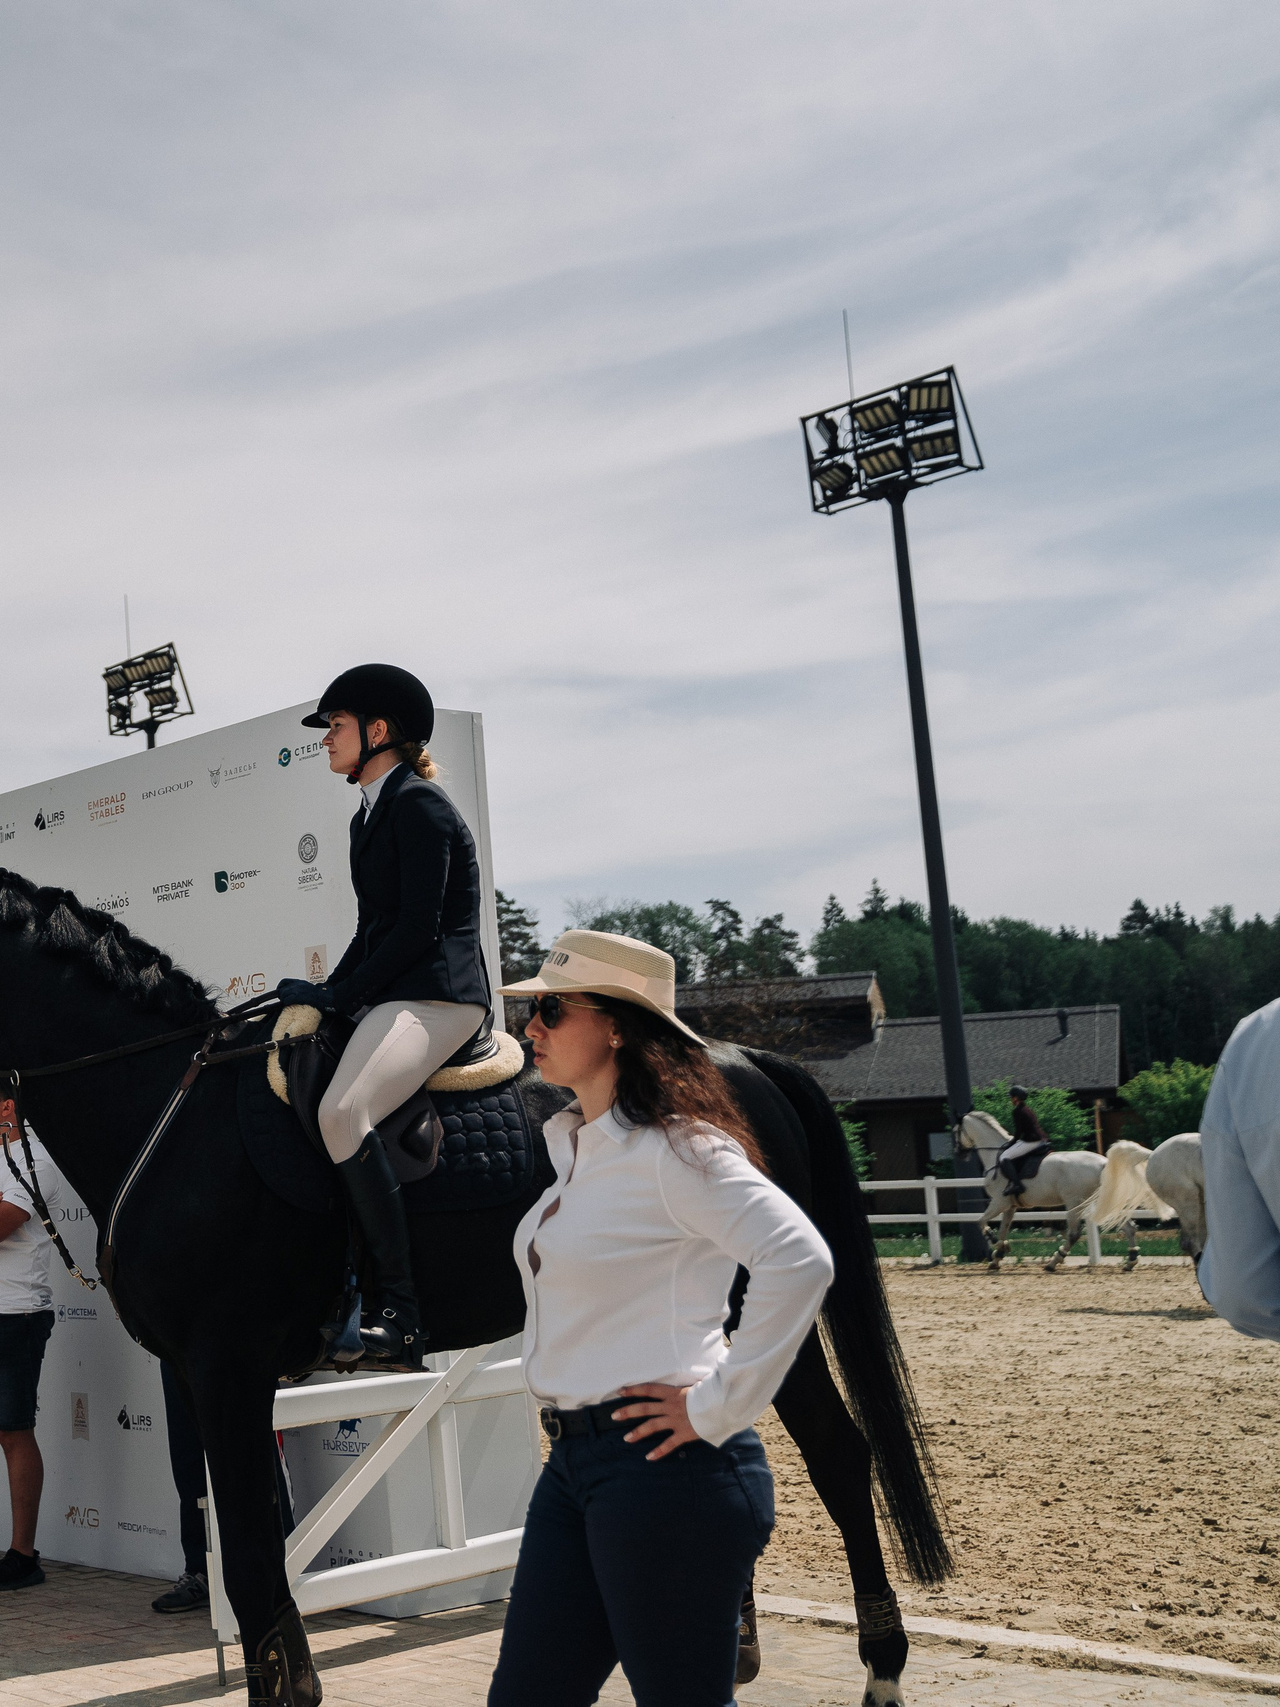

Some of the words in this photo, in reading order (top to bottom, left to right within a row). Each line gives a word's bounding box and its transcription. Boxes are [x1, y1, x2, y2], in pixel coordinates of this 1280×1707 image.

[141, 790, 156, 800] BN
[157, 780, 194, 796] GROUP
[88, 792, 126, 811] EMERALD
[47, 810, 65, 824] LIRS
[90, 804, 125, 822] STABLES
[298, 872, 323, 885] SIBERICA
[152, 883, 170, 895] MTS
[171, 878, 194, 891] BANK
[157, 889, 190, 903] PRIVATE
[67, 1308, 97, 1317] СИСТЕМА
[132, 1414, 152, 1427] LIRS
[142, 1525, 167, 1536] Premium
[329, 1547, 383, 1559] TARGET
